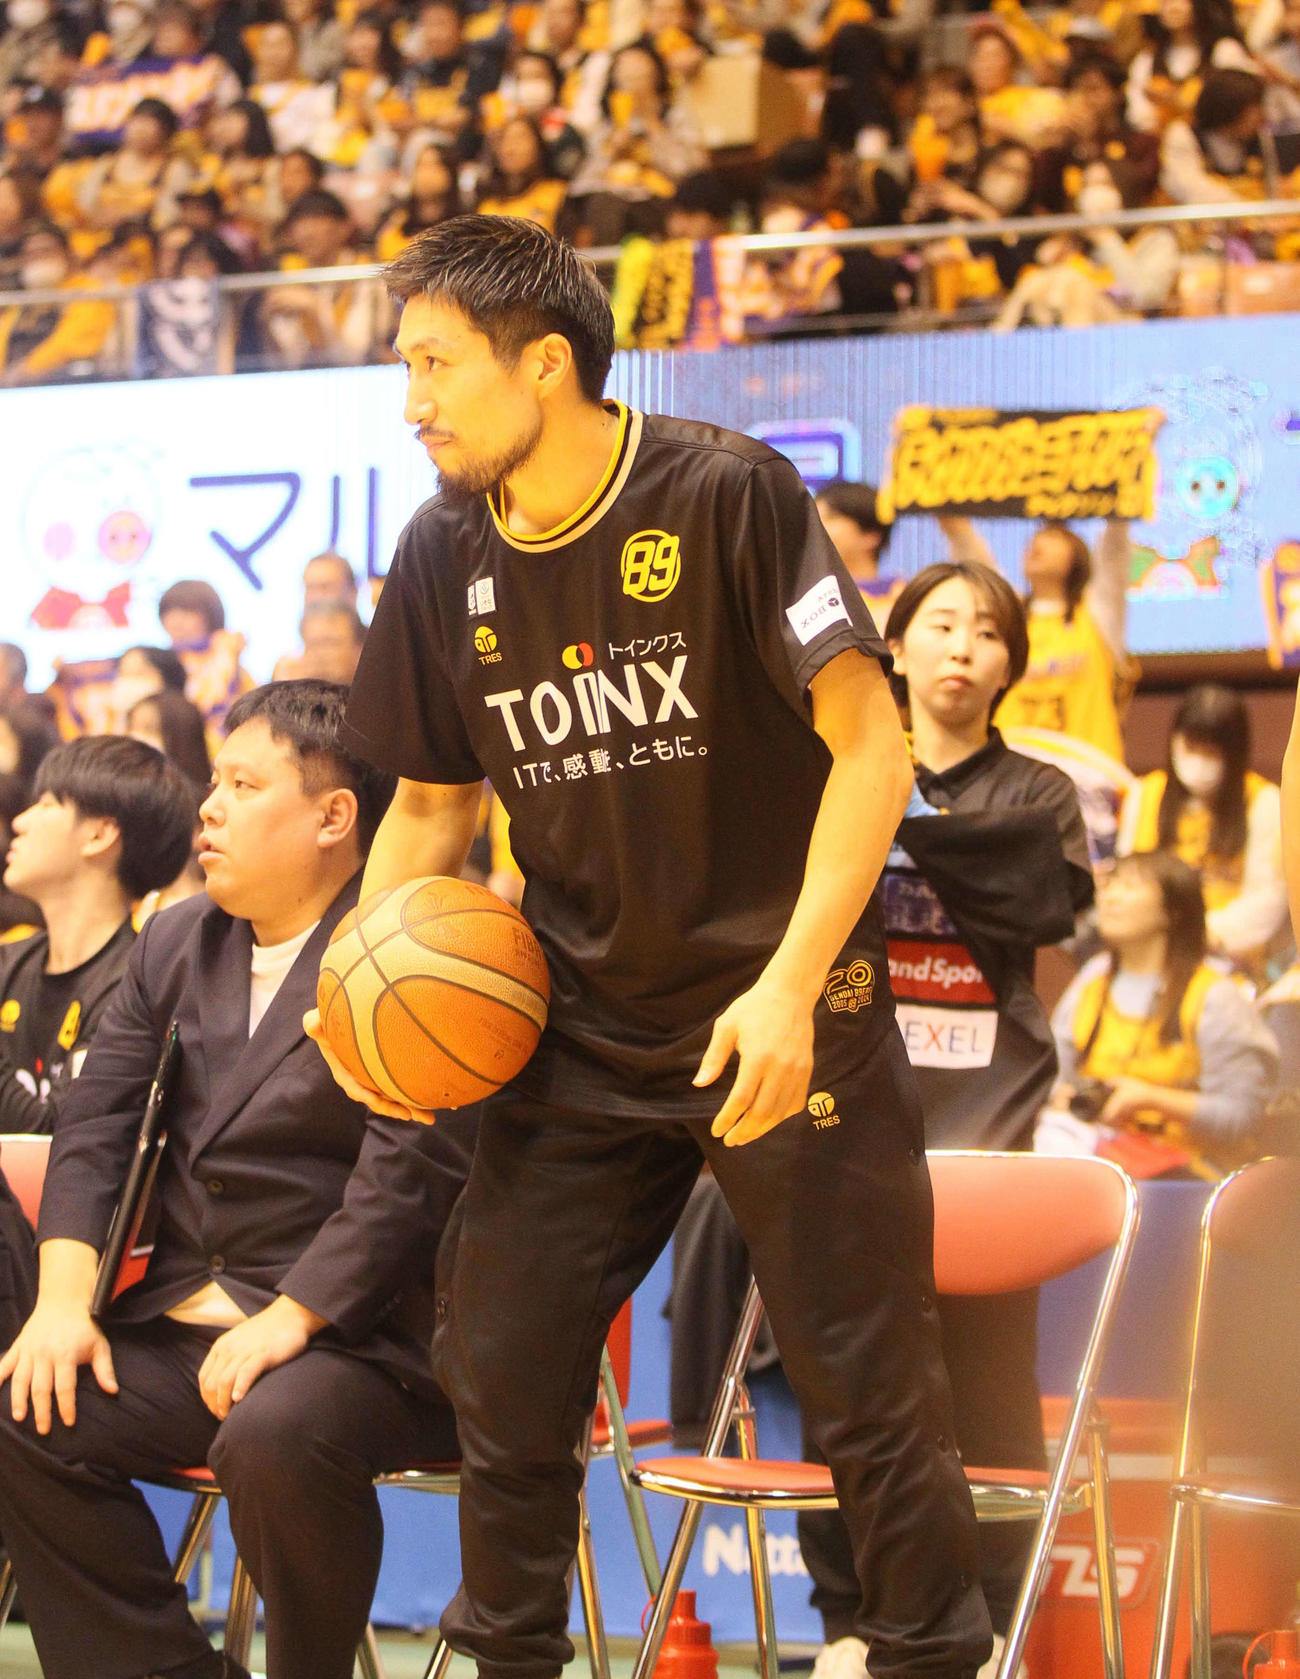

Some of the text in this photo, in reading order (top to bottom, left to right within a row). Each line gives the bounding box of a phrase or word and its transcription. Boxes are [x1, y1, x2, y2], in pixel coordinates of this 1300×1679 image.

[622, 534, 681, 596] 89
[608, 631, 687, 660] トインクス
[478, 652, 503, 666] TRES
[812, 1114, 841, 1131] TRES
